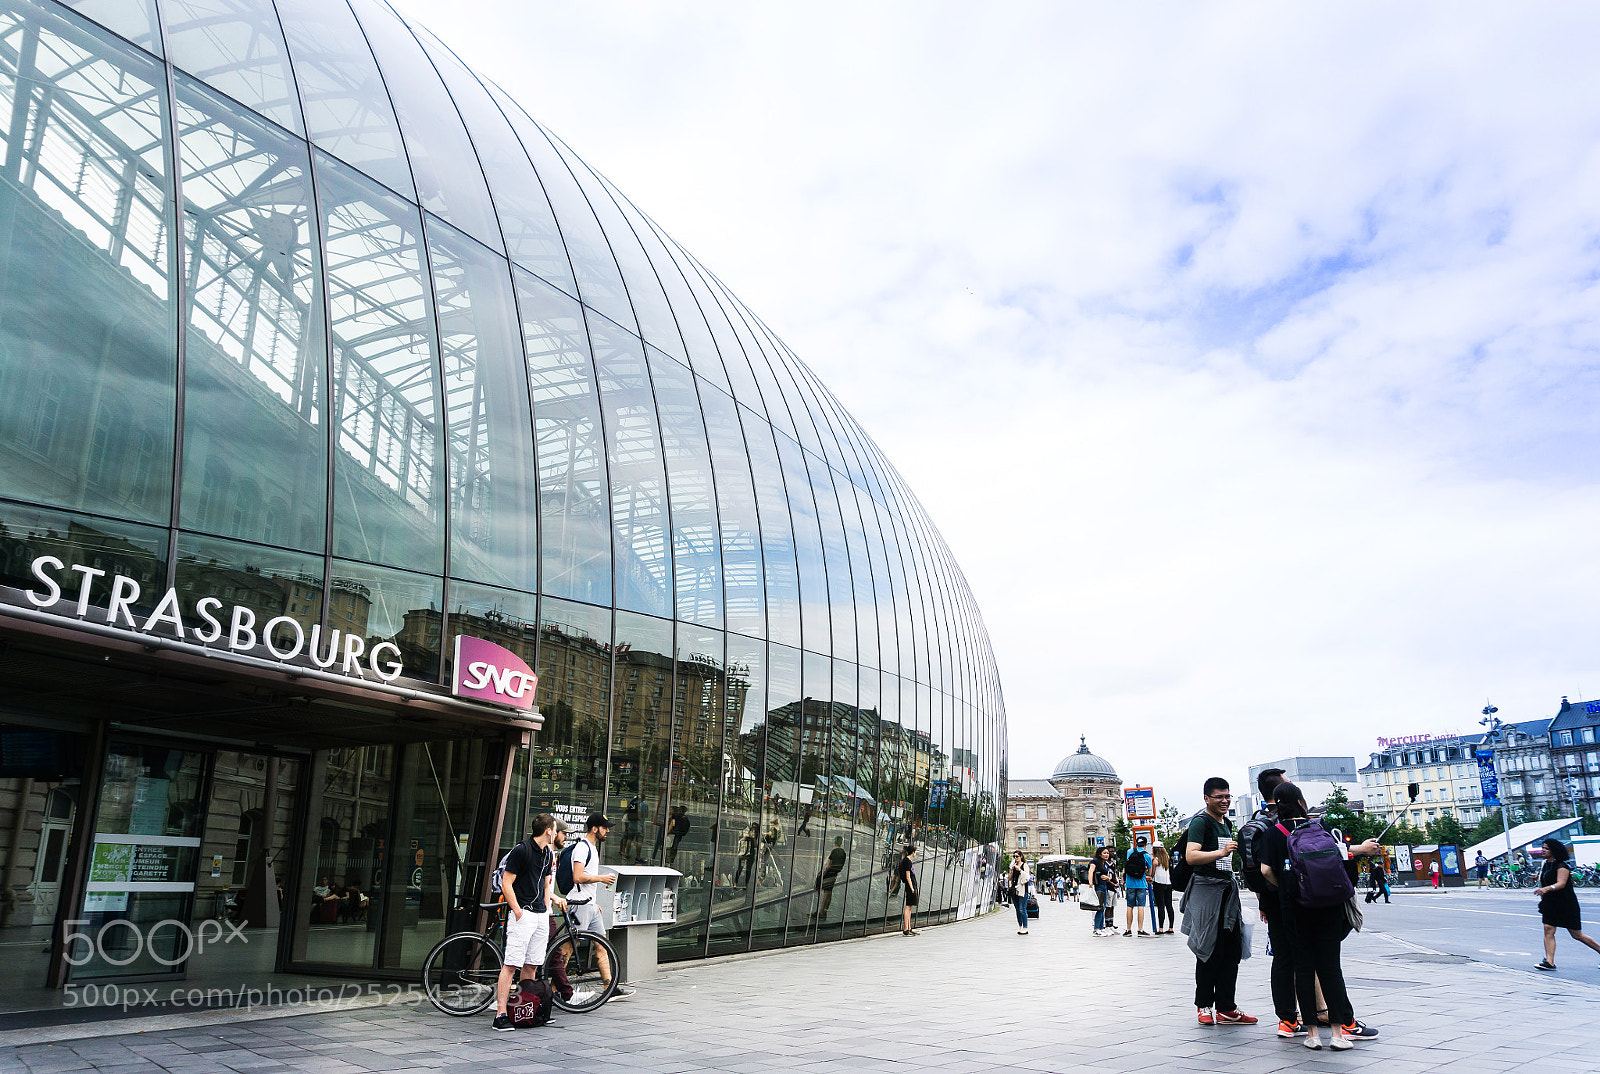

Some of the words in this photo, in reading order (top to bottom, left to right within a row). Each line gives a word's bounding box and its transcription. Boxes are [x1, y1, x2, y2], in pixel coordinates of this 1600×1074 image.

[25, 555, 403, 682] STRASBOURG
[462, 661, 536, 698] SNCF
[1376, 733, 1431, 746] mercure
[555, 804, 568, 813] VOUS
[569, 805, 588, 814] ENTREZ
[572, 815, 590, 823] ESPAC
